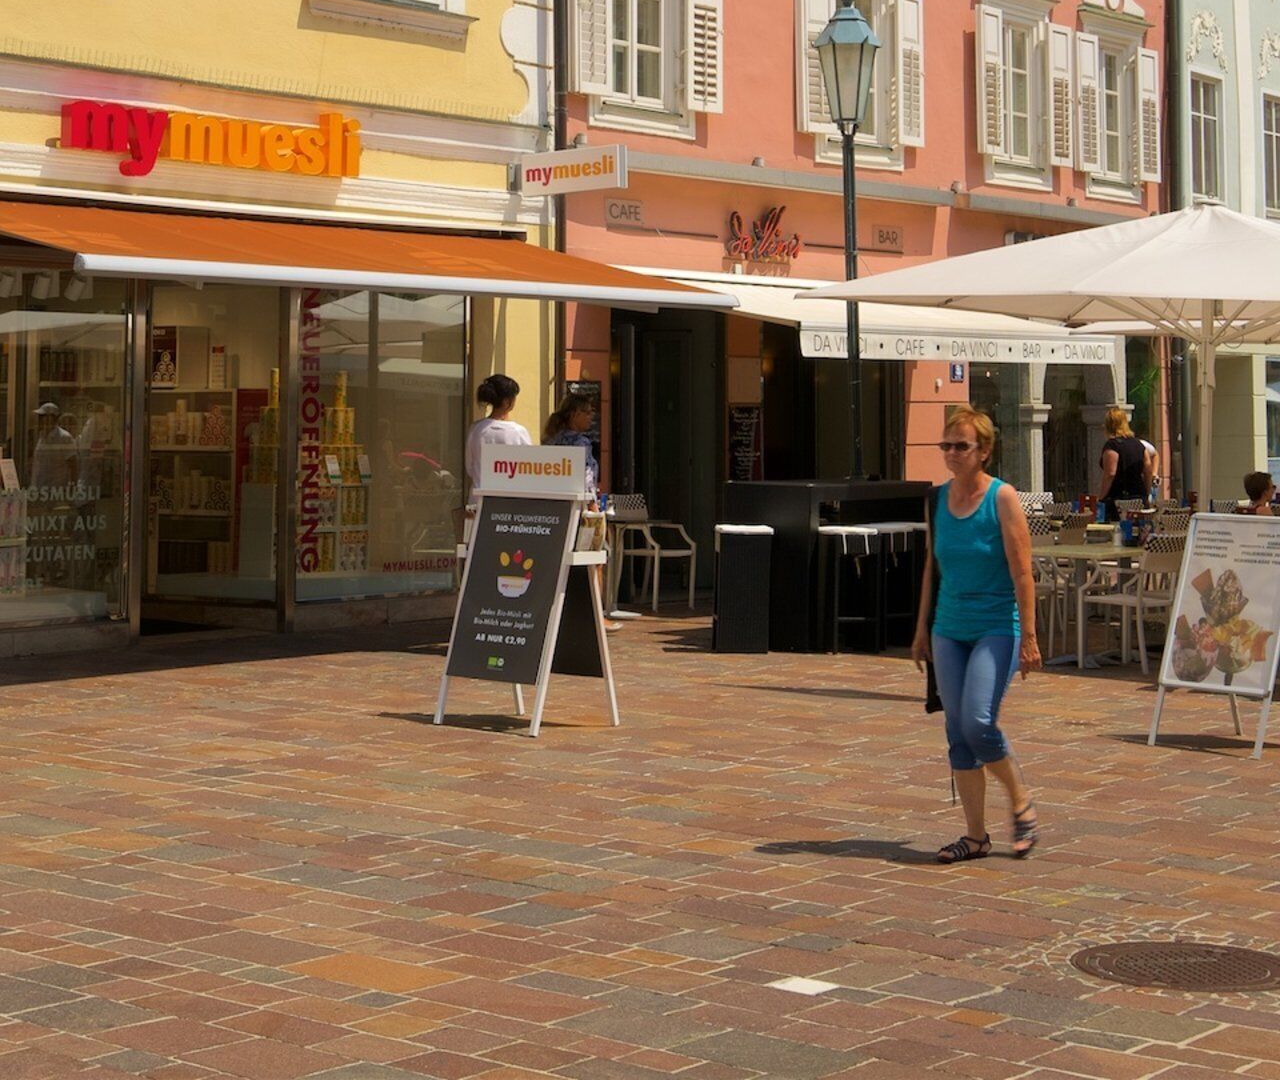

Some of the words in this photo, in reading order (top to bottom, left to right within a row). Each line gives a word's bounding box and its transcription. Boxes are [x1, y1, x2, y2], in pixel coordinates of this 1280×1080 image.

[61, 100, 361, 177] mymuesli
[525, 154, 615, 187] mymuesli
[608, 202, 642, 221] CAFE
[877, 229, 899, 245] BAR
[813, 334, 832, 352] DA
[833, 335, 868, 354] VICI
[895, 337, 925, 356] CAFE
[951, 339, 967, 357] DA
[968, 340, 999, 358] VINCI
[1022, 341, 1042, 358] BAR
[1064, 343, 1081, 360] DA
[1081, 344, 1106, 361] VINCI
[300, 286, 324, 574] NEUERÖFFNUNG
[493, 458, 573, 479] mymuesli
[73, 515, 107, 532] AUS
[490, 513, 512, 522] UNSER
[513, 513, 560, 525] VOLLWERTIGES
[495, 523, 552, 536] BIO-FRÜHSTÜCK
[24, 544, 95, 562] ZUTATEN
[382, 556, 458, 573] MYMUESLI.COM
[475, 632, 486, 642] AB
[487, 633, 503, 643] NUR
[504, 635, 527, 646] €2,90
